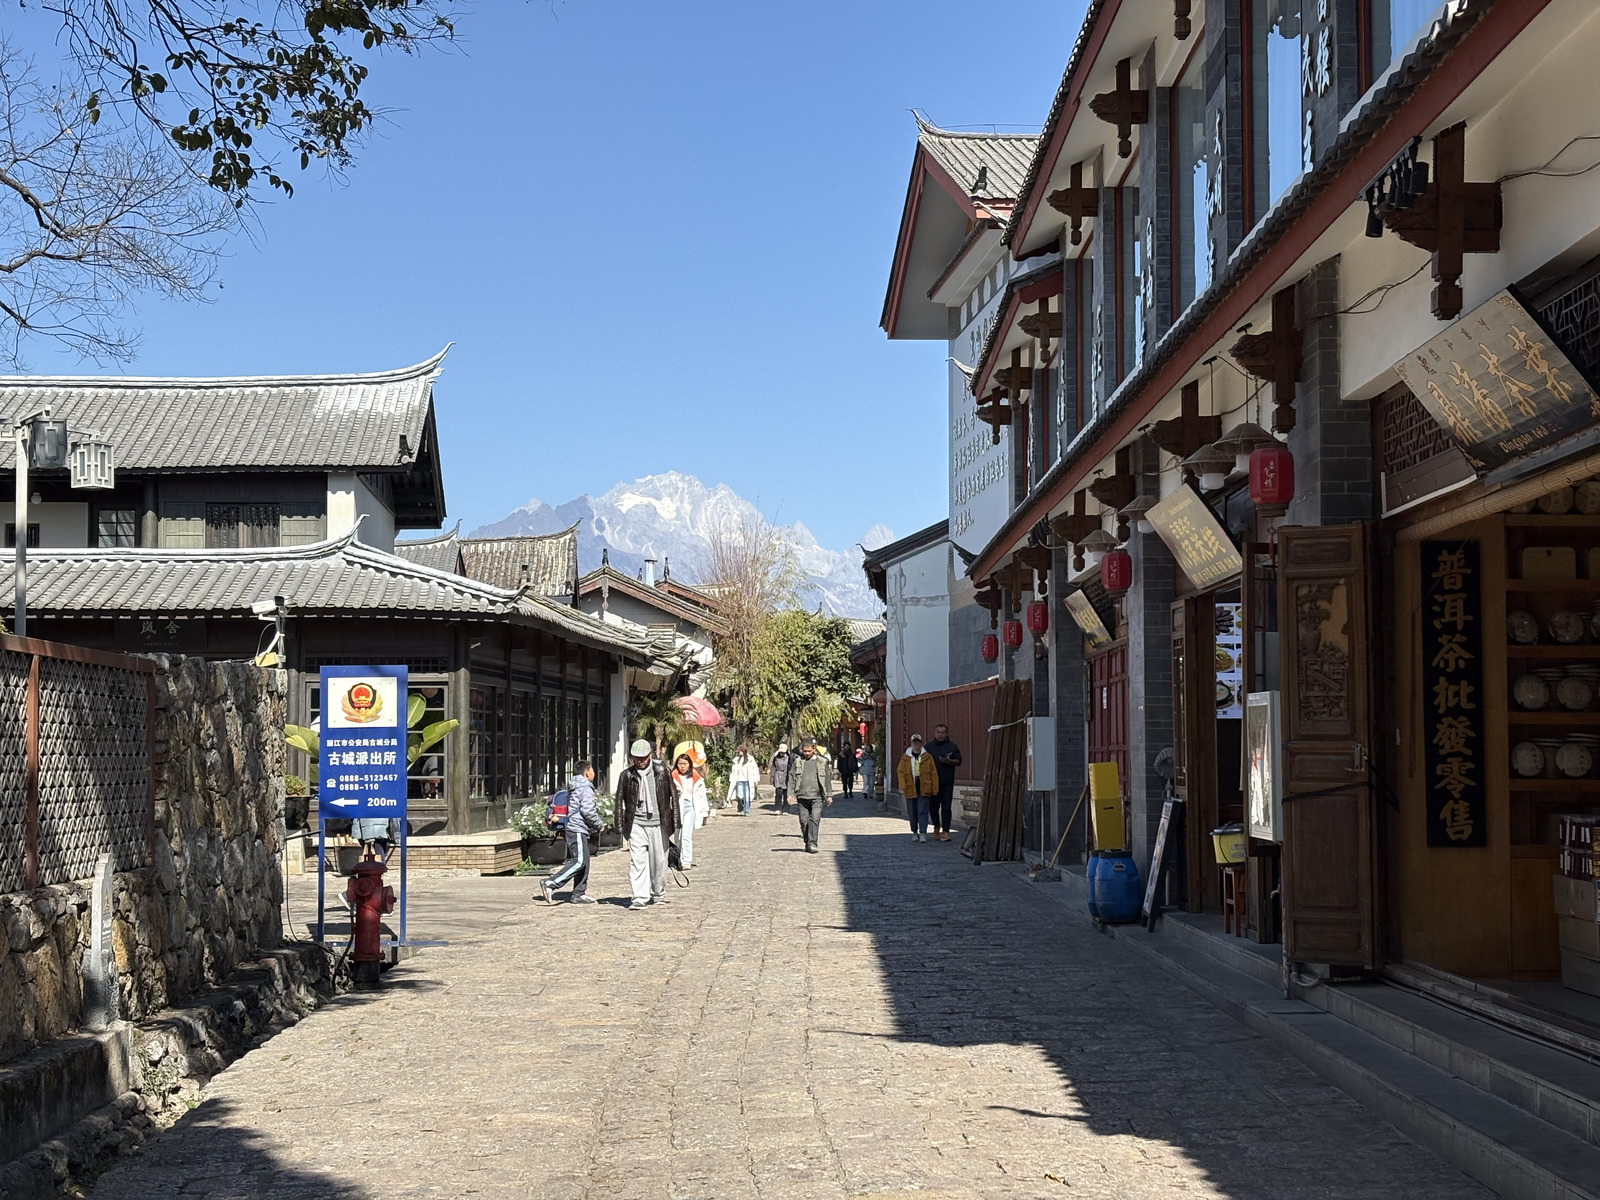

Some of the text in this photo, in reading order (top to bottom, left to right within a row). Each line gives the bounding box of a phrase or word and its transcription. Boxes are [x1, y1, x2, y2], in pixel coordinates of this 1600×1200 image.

[1302, 33, 1314, 174] 民主
[1212, 107, 1222, 216] 文明
[1146, 216, 1153, 309] 自由
[1499, 433, 1533, 454] Dingpan
[1532, 425, 1550, 440] tea
[1430, 549, 1477, 841] 普洱茶批發零售
[326, 739, 398, 747] 丽江市公安局古城分局
[327, 751, 397, 766] 古城派出所
[339, 774, 398, 782] 0888-5123457
[339, 783, 379, 791] 0888-110
[367, 797, 397, 807] 200m
